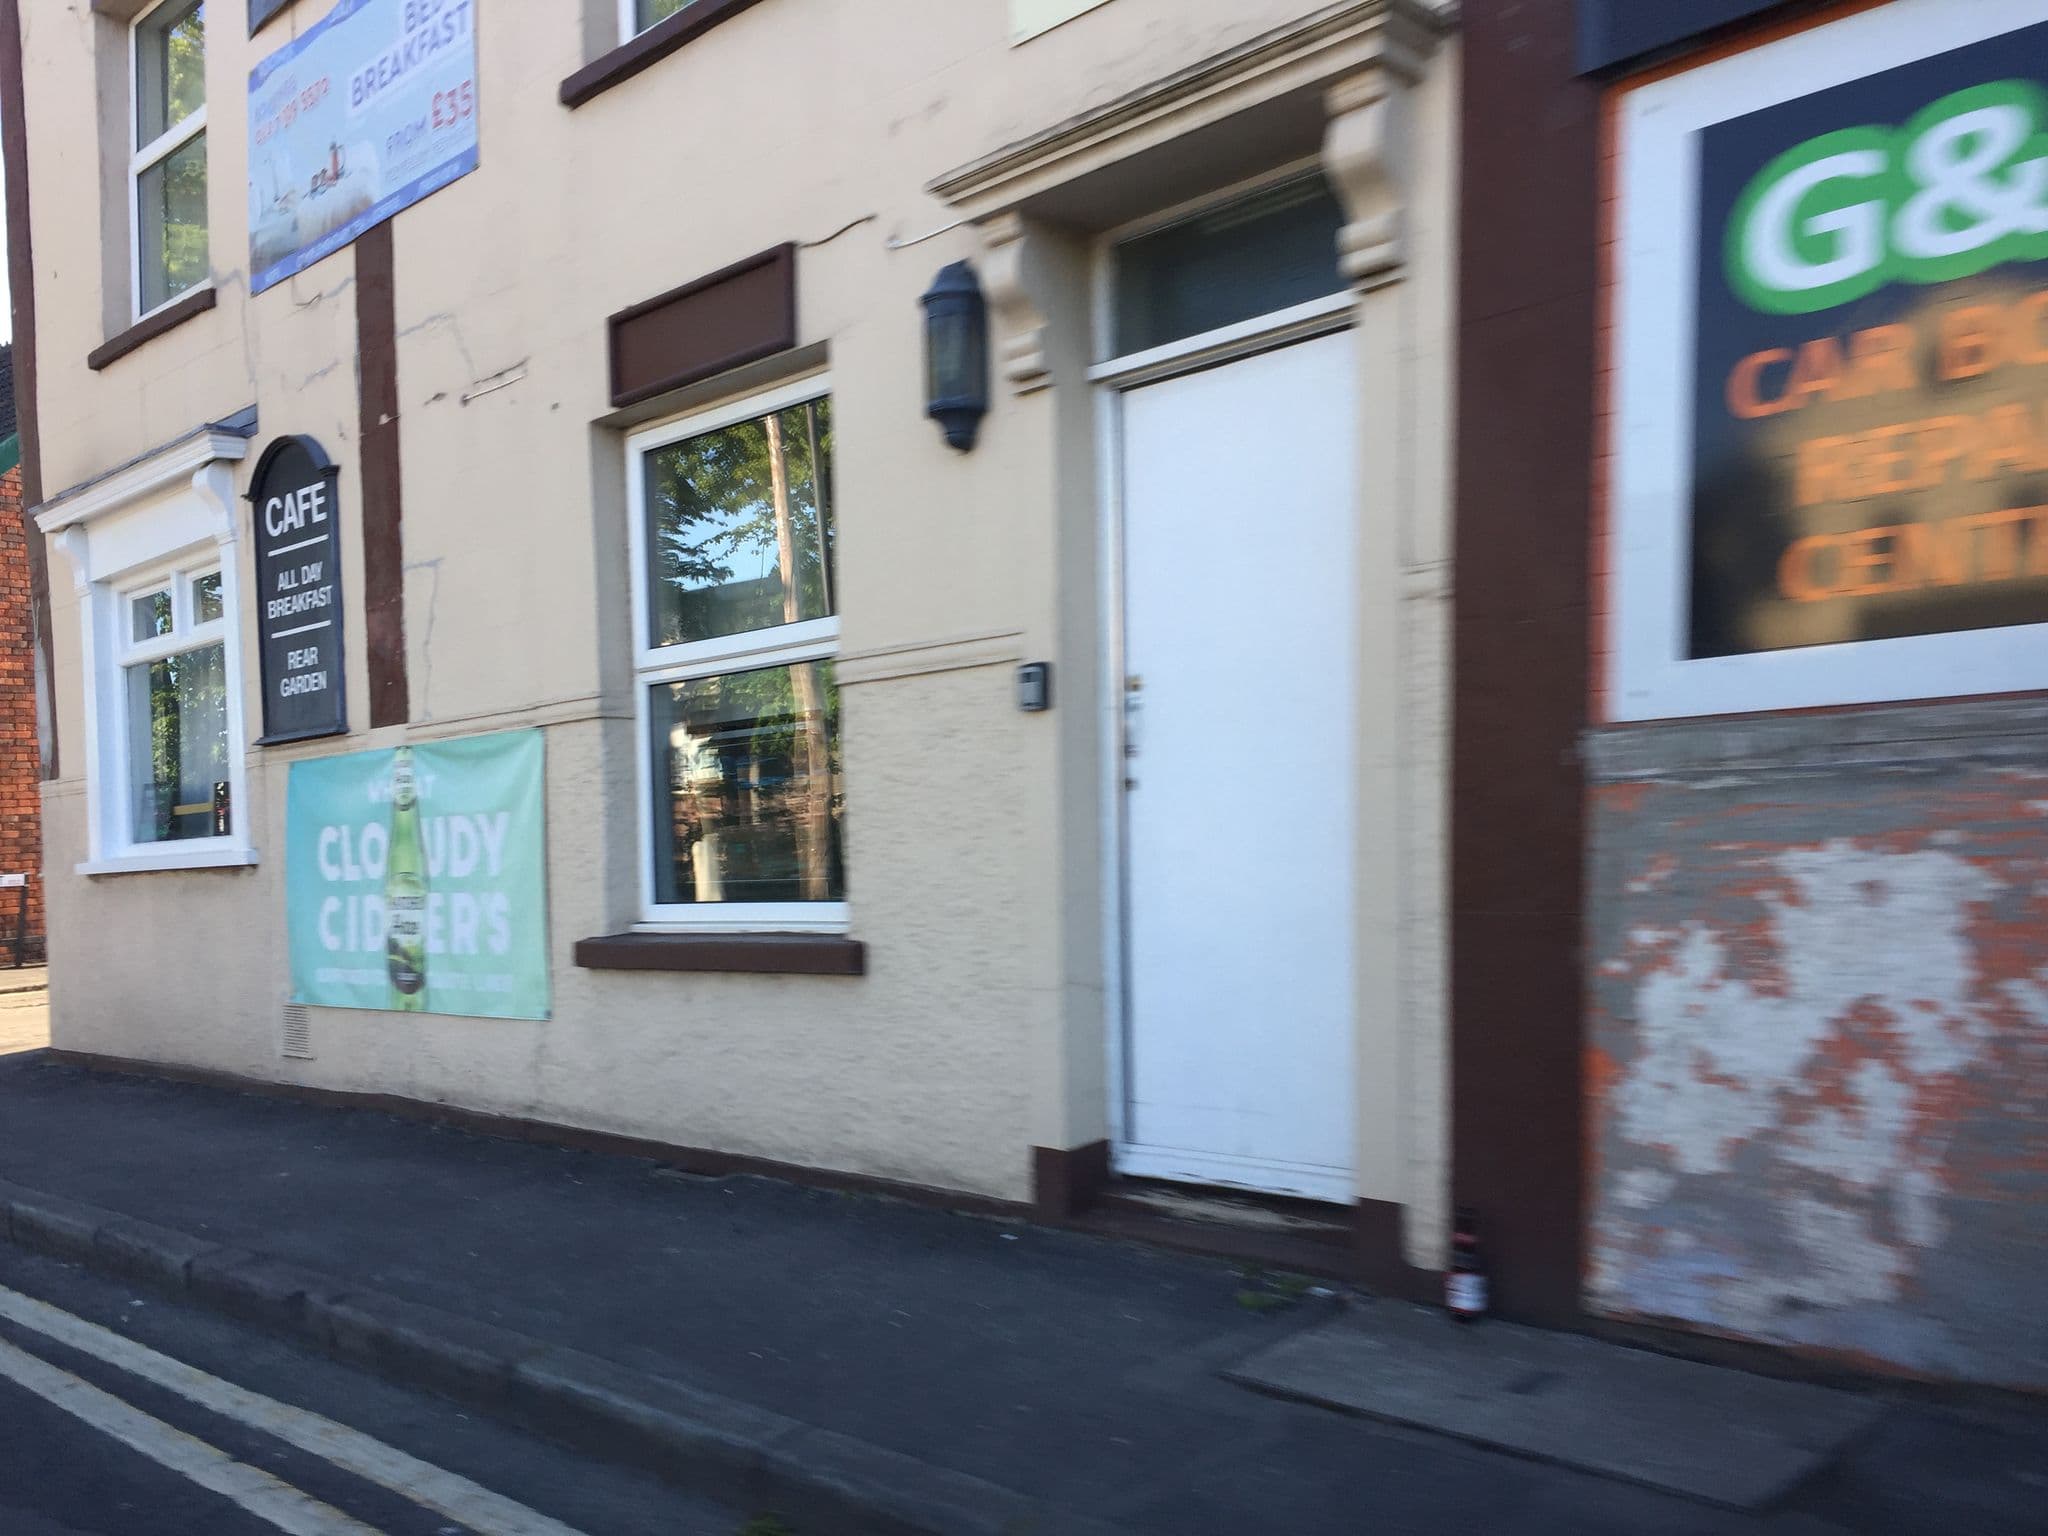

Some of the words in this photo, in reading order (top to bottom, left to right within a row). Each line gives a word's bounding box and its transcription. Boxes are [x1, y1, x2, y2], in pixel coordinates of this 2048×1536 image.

[350, 0, 469, 109] BREAKFAST
[431, 79, 473, 129] £35
[1725, 323, 1919, 420] CAR
[1795, 400, 2048, 507] REPA
[265, 480, 328, 537] CAFE
[267, 585, 333, 619] BREAKFAST
[277, 565, 299, 592] ALL
[301, 561, 323, 586] DAY
[280, 671, 328, 697] GARDEN
[287, 646, 318, 670] REAR
[317, 811, 510, 881] CLOUDY
